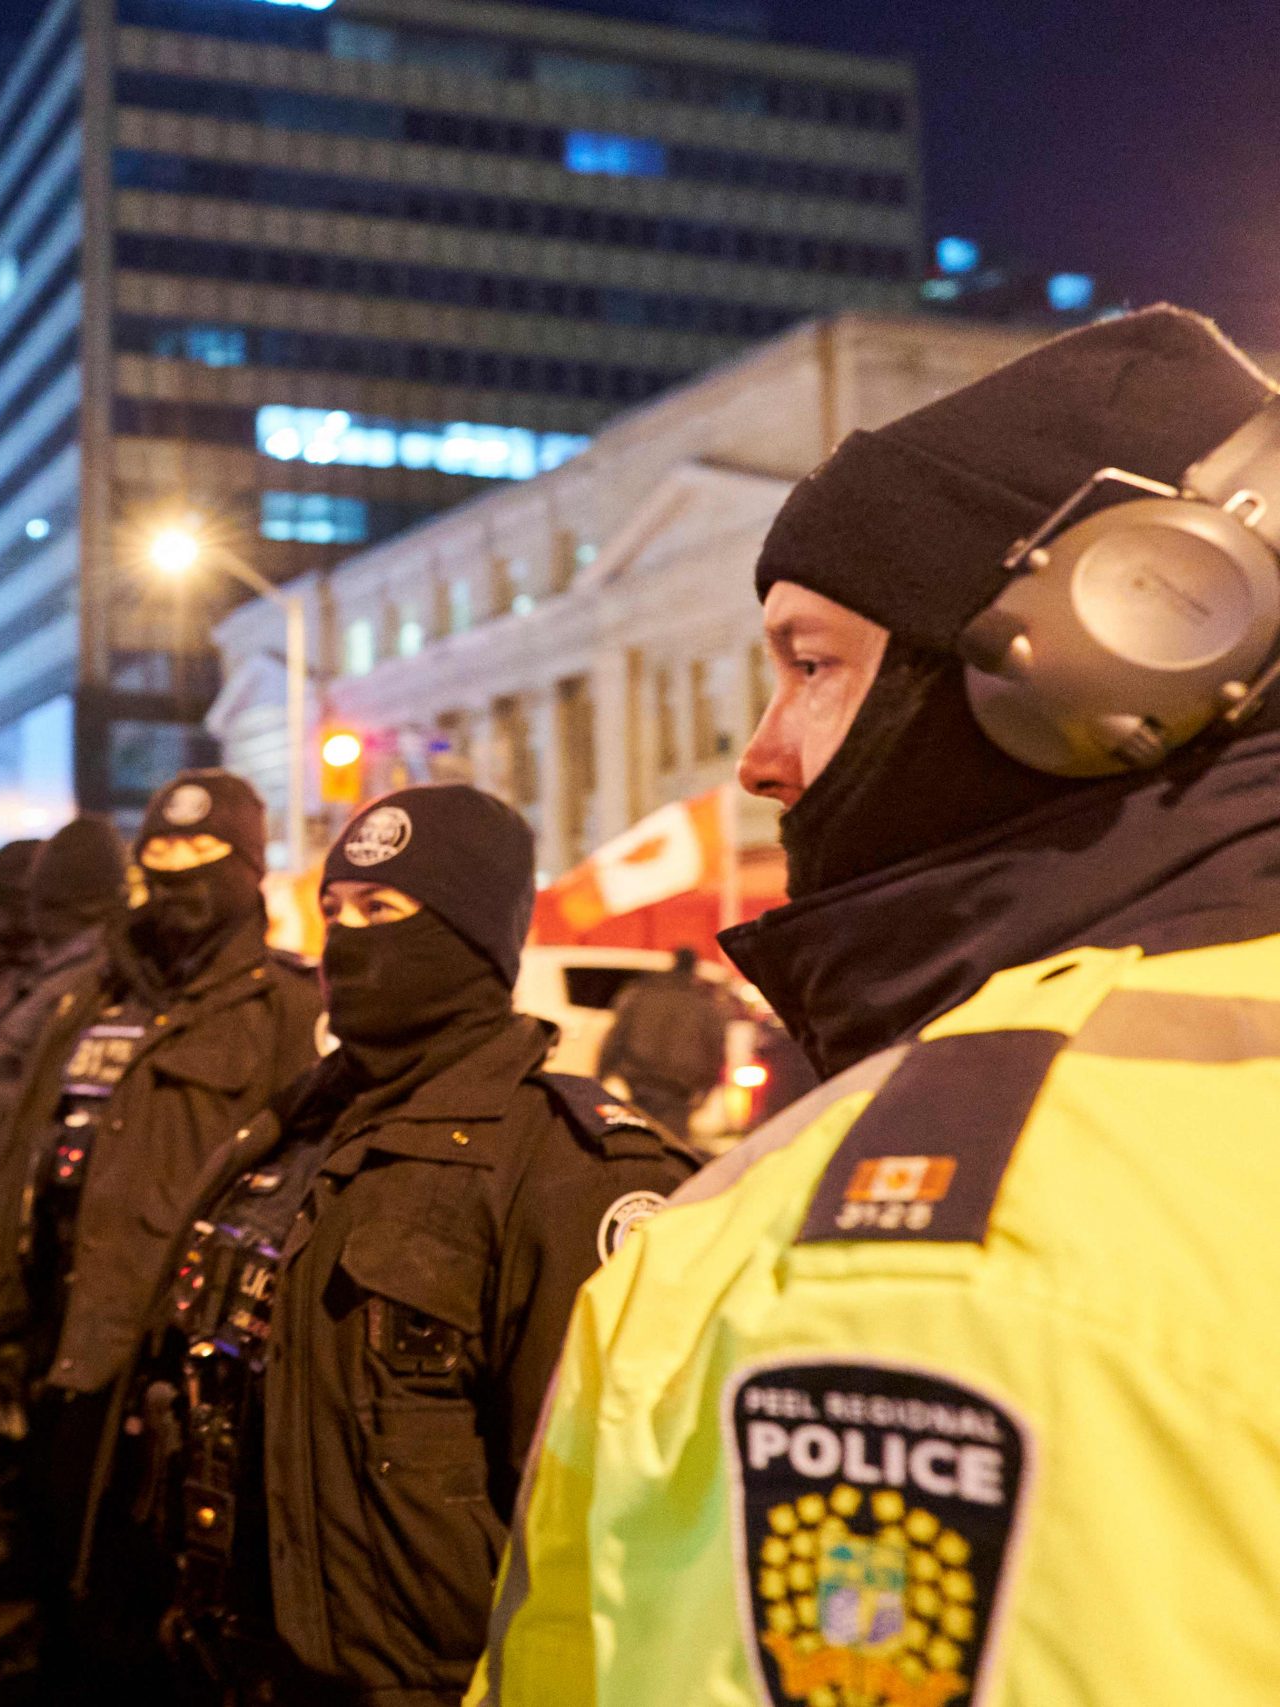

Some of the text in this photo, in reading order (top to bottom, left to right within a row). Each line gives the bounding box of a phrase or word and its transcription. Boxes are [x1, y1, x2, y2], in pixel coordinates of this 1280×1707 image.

[742, 1386, 1006, 1443] PEEL REGIONAL
[745, 1421, 1005, 1506] POLICE
